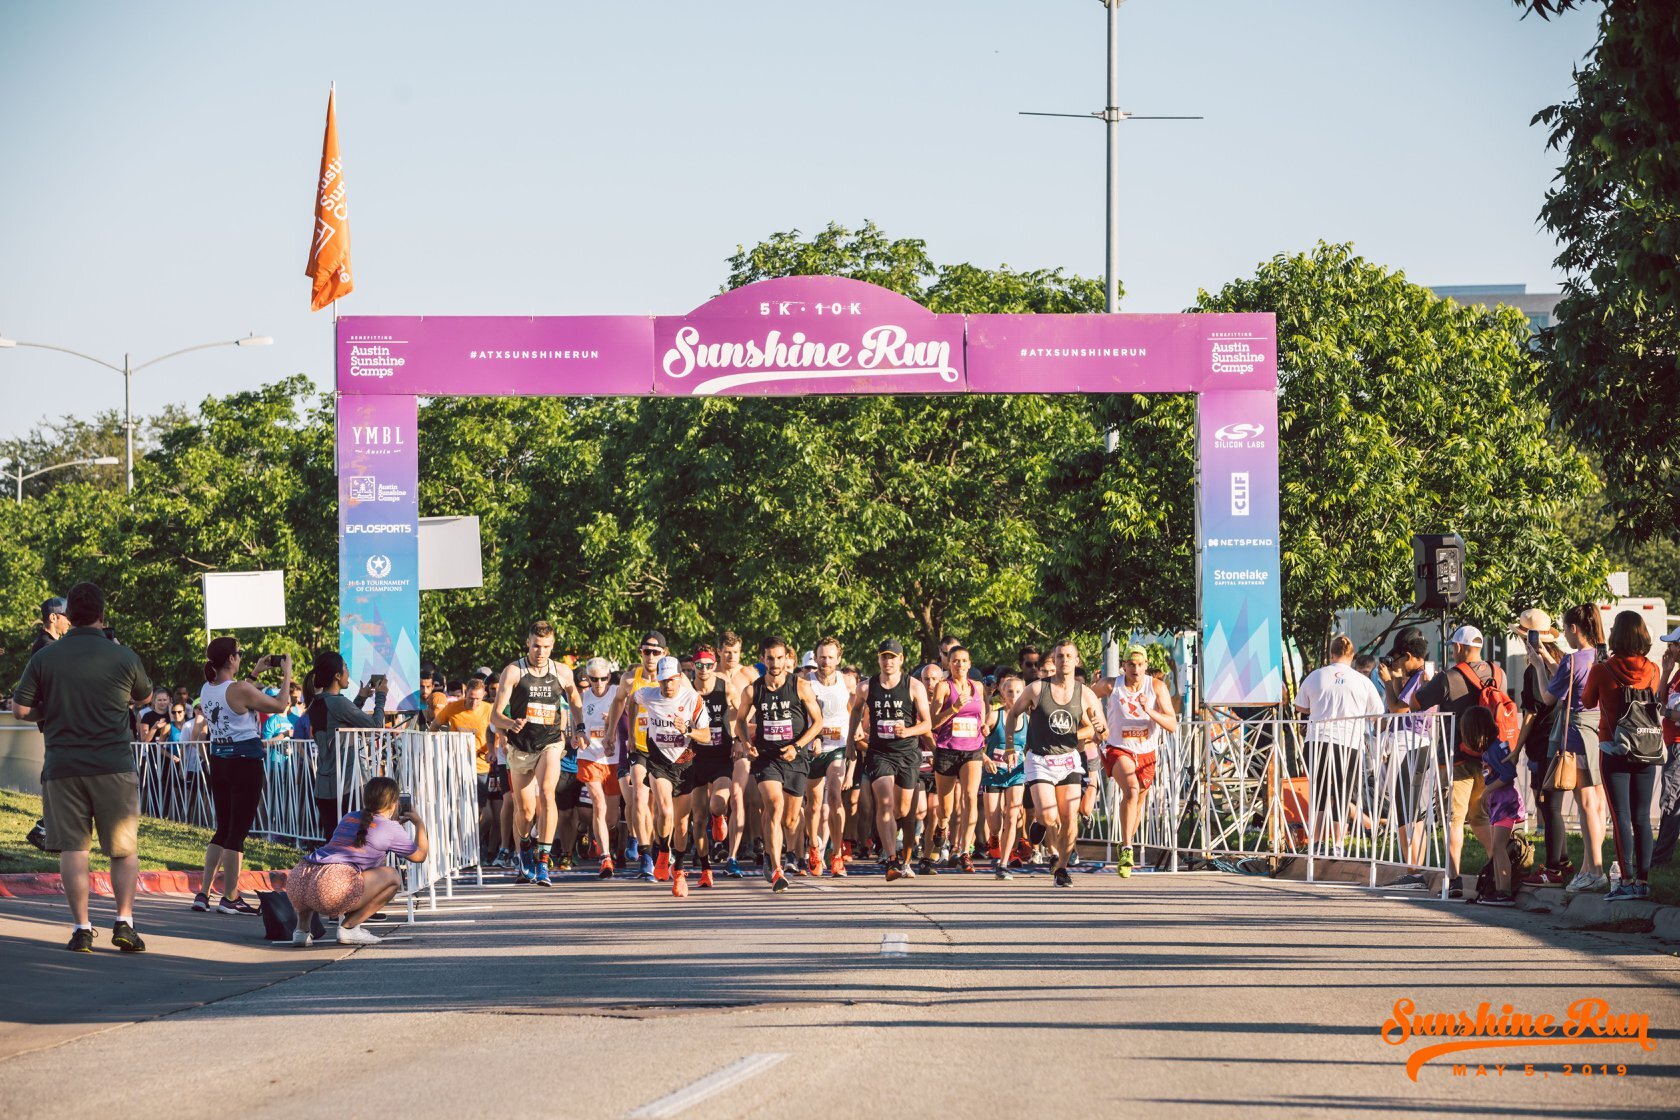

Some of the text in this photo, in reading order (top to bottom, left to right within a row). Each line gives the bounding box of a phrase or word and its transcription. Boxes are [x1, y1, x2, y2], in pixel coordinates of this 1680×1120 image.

[350, 345, 390, 356] Austin
[1020, 348, 1147, 357] #ATXSUNSHINERUN
[1211, 342, 1250, 352] Austin
[469, 350, 599, 359] #ATXSUNSHINERUN
[662, 324, 959, 383] Sunshine Run
[1211, 352, 1265, 363] Sunshine
[350, 356, 405, 366] Sunshine
[350, 366, 394, 379] Camps
[1211, 363, 1254, 375] Camps
[352, 426, 404, 445] YMBL
[1214, 441, 1265, 449] SILICON LABS
[1234, 476, 1246, 510] CLIF
[354, 524, 412, 534] FLOSPORTS
[1214, 569, 1269, 581] Stonelake
[761, 700, 791, 711] RAW
[874, 700, 903, 708] RAW
